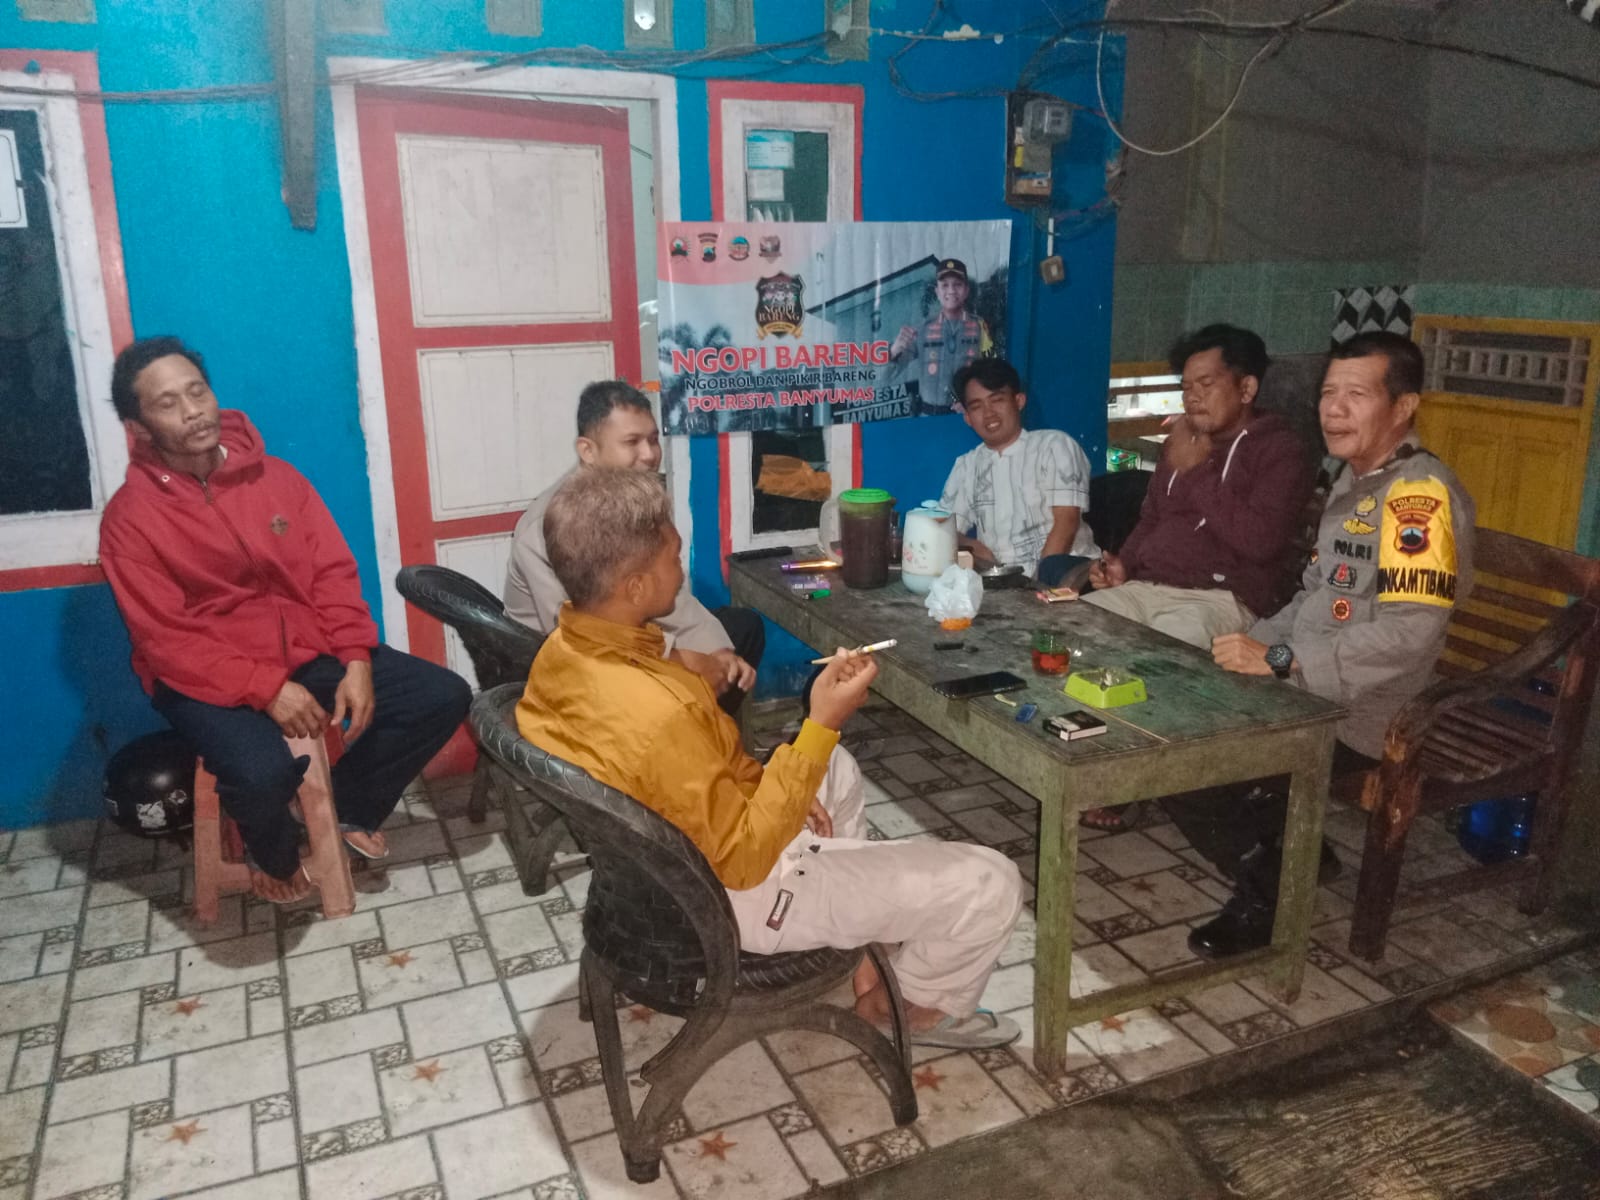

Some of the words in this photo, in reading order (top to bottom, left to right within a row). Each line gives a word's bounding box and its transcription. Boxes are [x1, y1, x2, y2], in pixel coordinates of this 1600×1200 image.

[671, 347, 767, 374] NGOPI
[775, 341, 890, 369] BARENG
[686, 376, 753, 391] NGOBROL
[756, 375, 785, 388] DAN
[788, 373, 822, 386] PIKIR
[826, 370, 877, 383] BARENG
[688, 391, 774, 413] POLRESTA
[780, 386, 875, 407] BANYUMAS
[1334, 539, 1372, 560] POLRI
